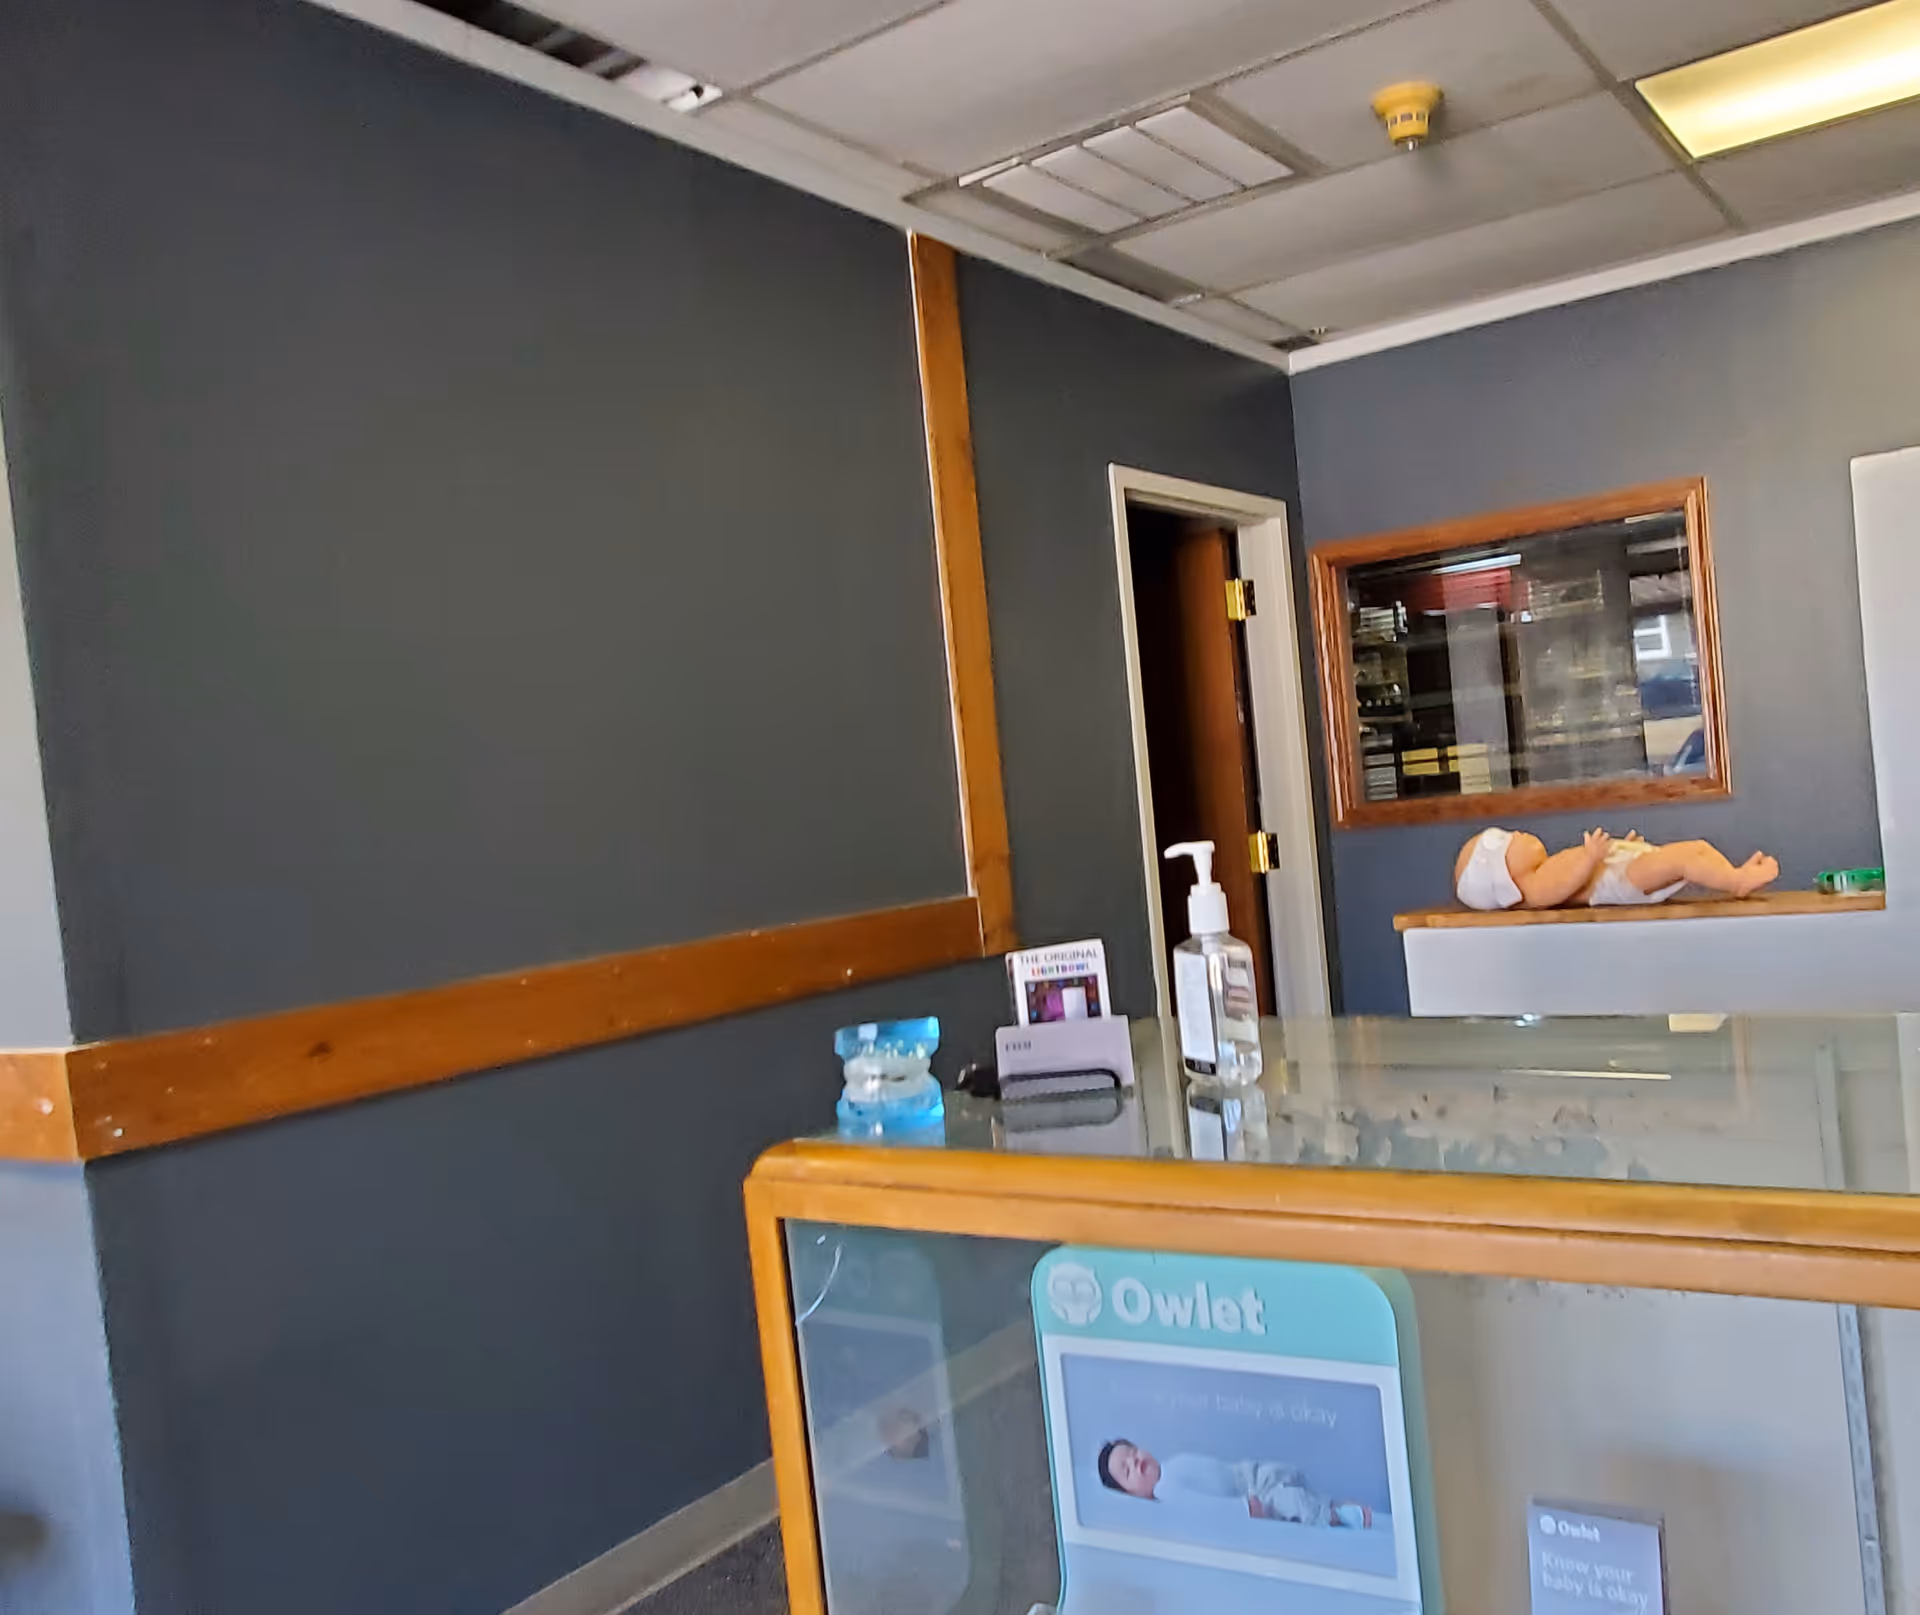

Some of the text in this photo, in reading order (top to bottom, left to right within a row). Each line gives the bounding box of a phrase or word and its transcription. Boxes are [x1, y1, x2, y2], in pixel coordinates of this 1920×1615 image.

[1020, 948, 1098, 965] THE ORIGINAL
[1112, 1277, 1268, 1335] Owlet
[1290, 1394, 1338, 1430] okay
[1558, 1520, 1601, 1542] Owlet
[1542, 1551, 1634, 1584] Know your
[1541, 1570, 1584, 1596] baby
[1607, 1585, 1648, 1607] okay
